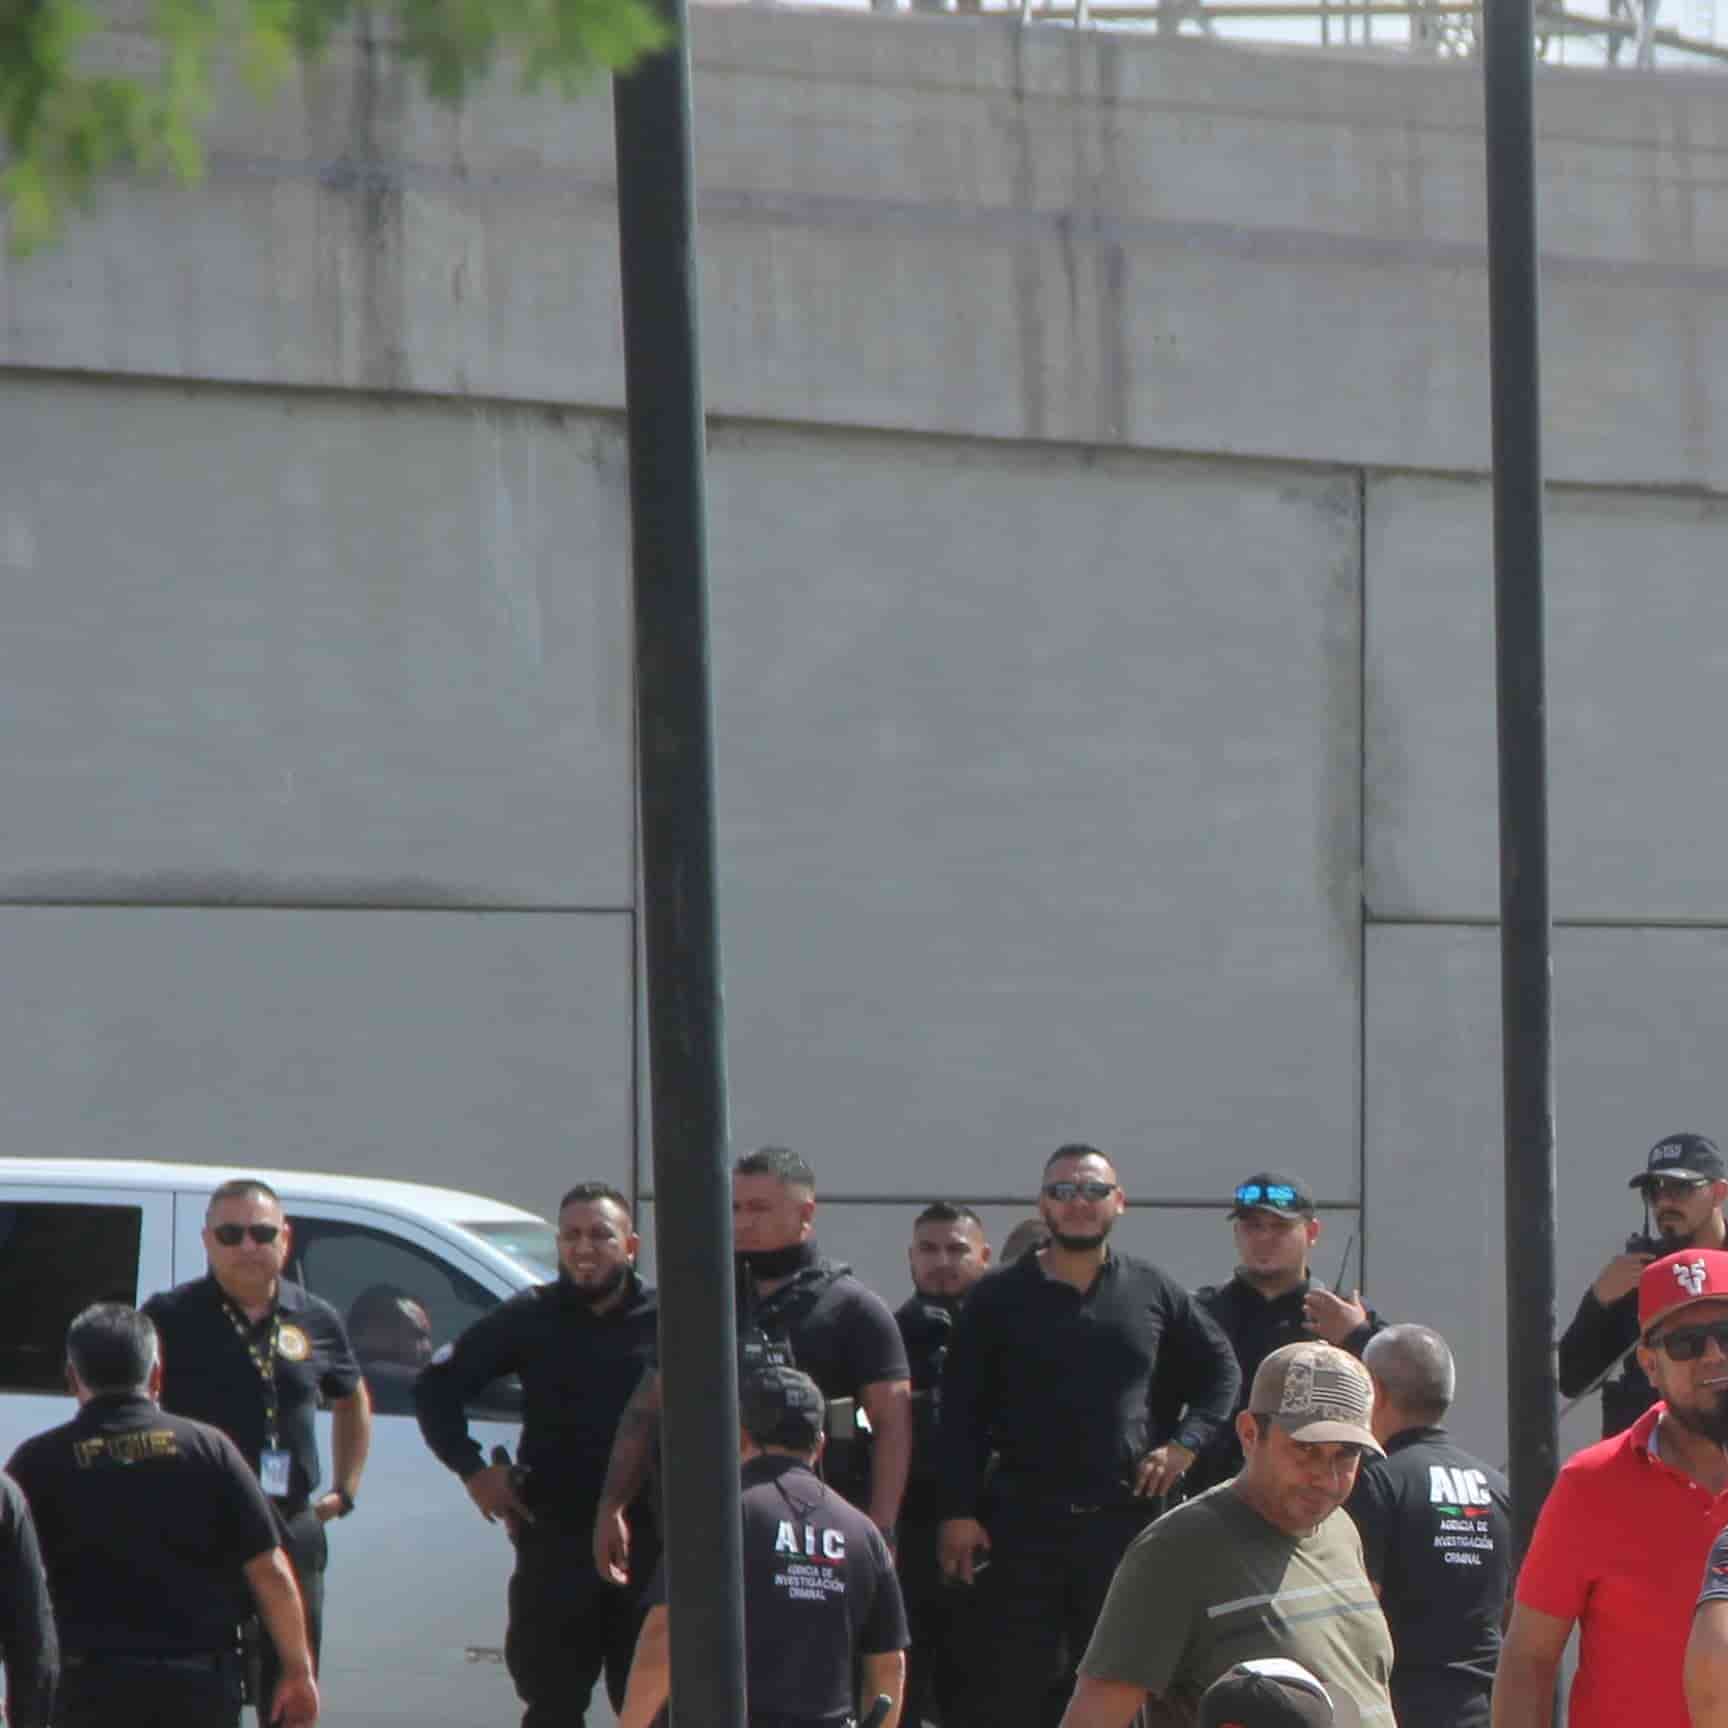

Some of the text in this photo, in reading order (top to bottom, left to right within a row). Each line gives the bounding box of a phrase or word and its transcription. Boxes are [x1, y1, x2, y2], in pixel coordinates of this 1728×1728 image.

[1428, 1465, 1492, 1504] AIC
[775, 1519, 845, 1559] AIC
[1476, 1520, 1489, 1533] DE
